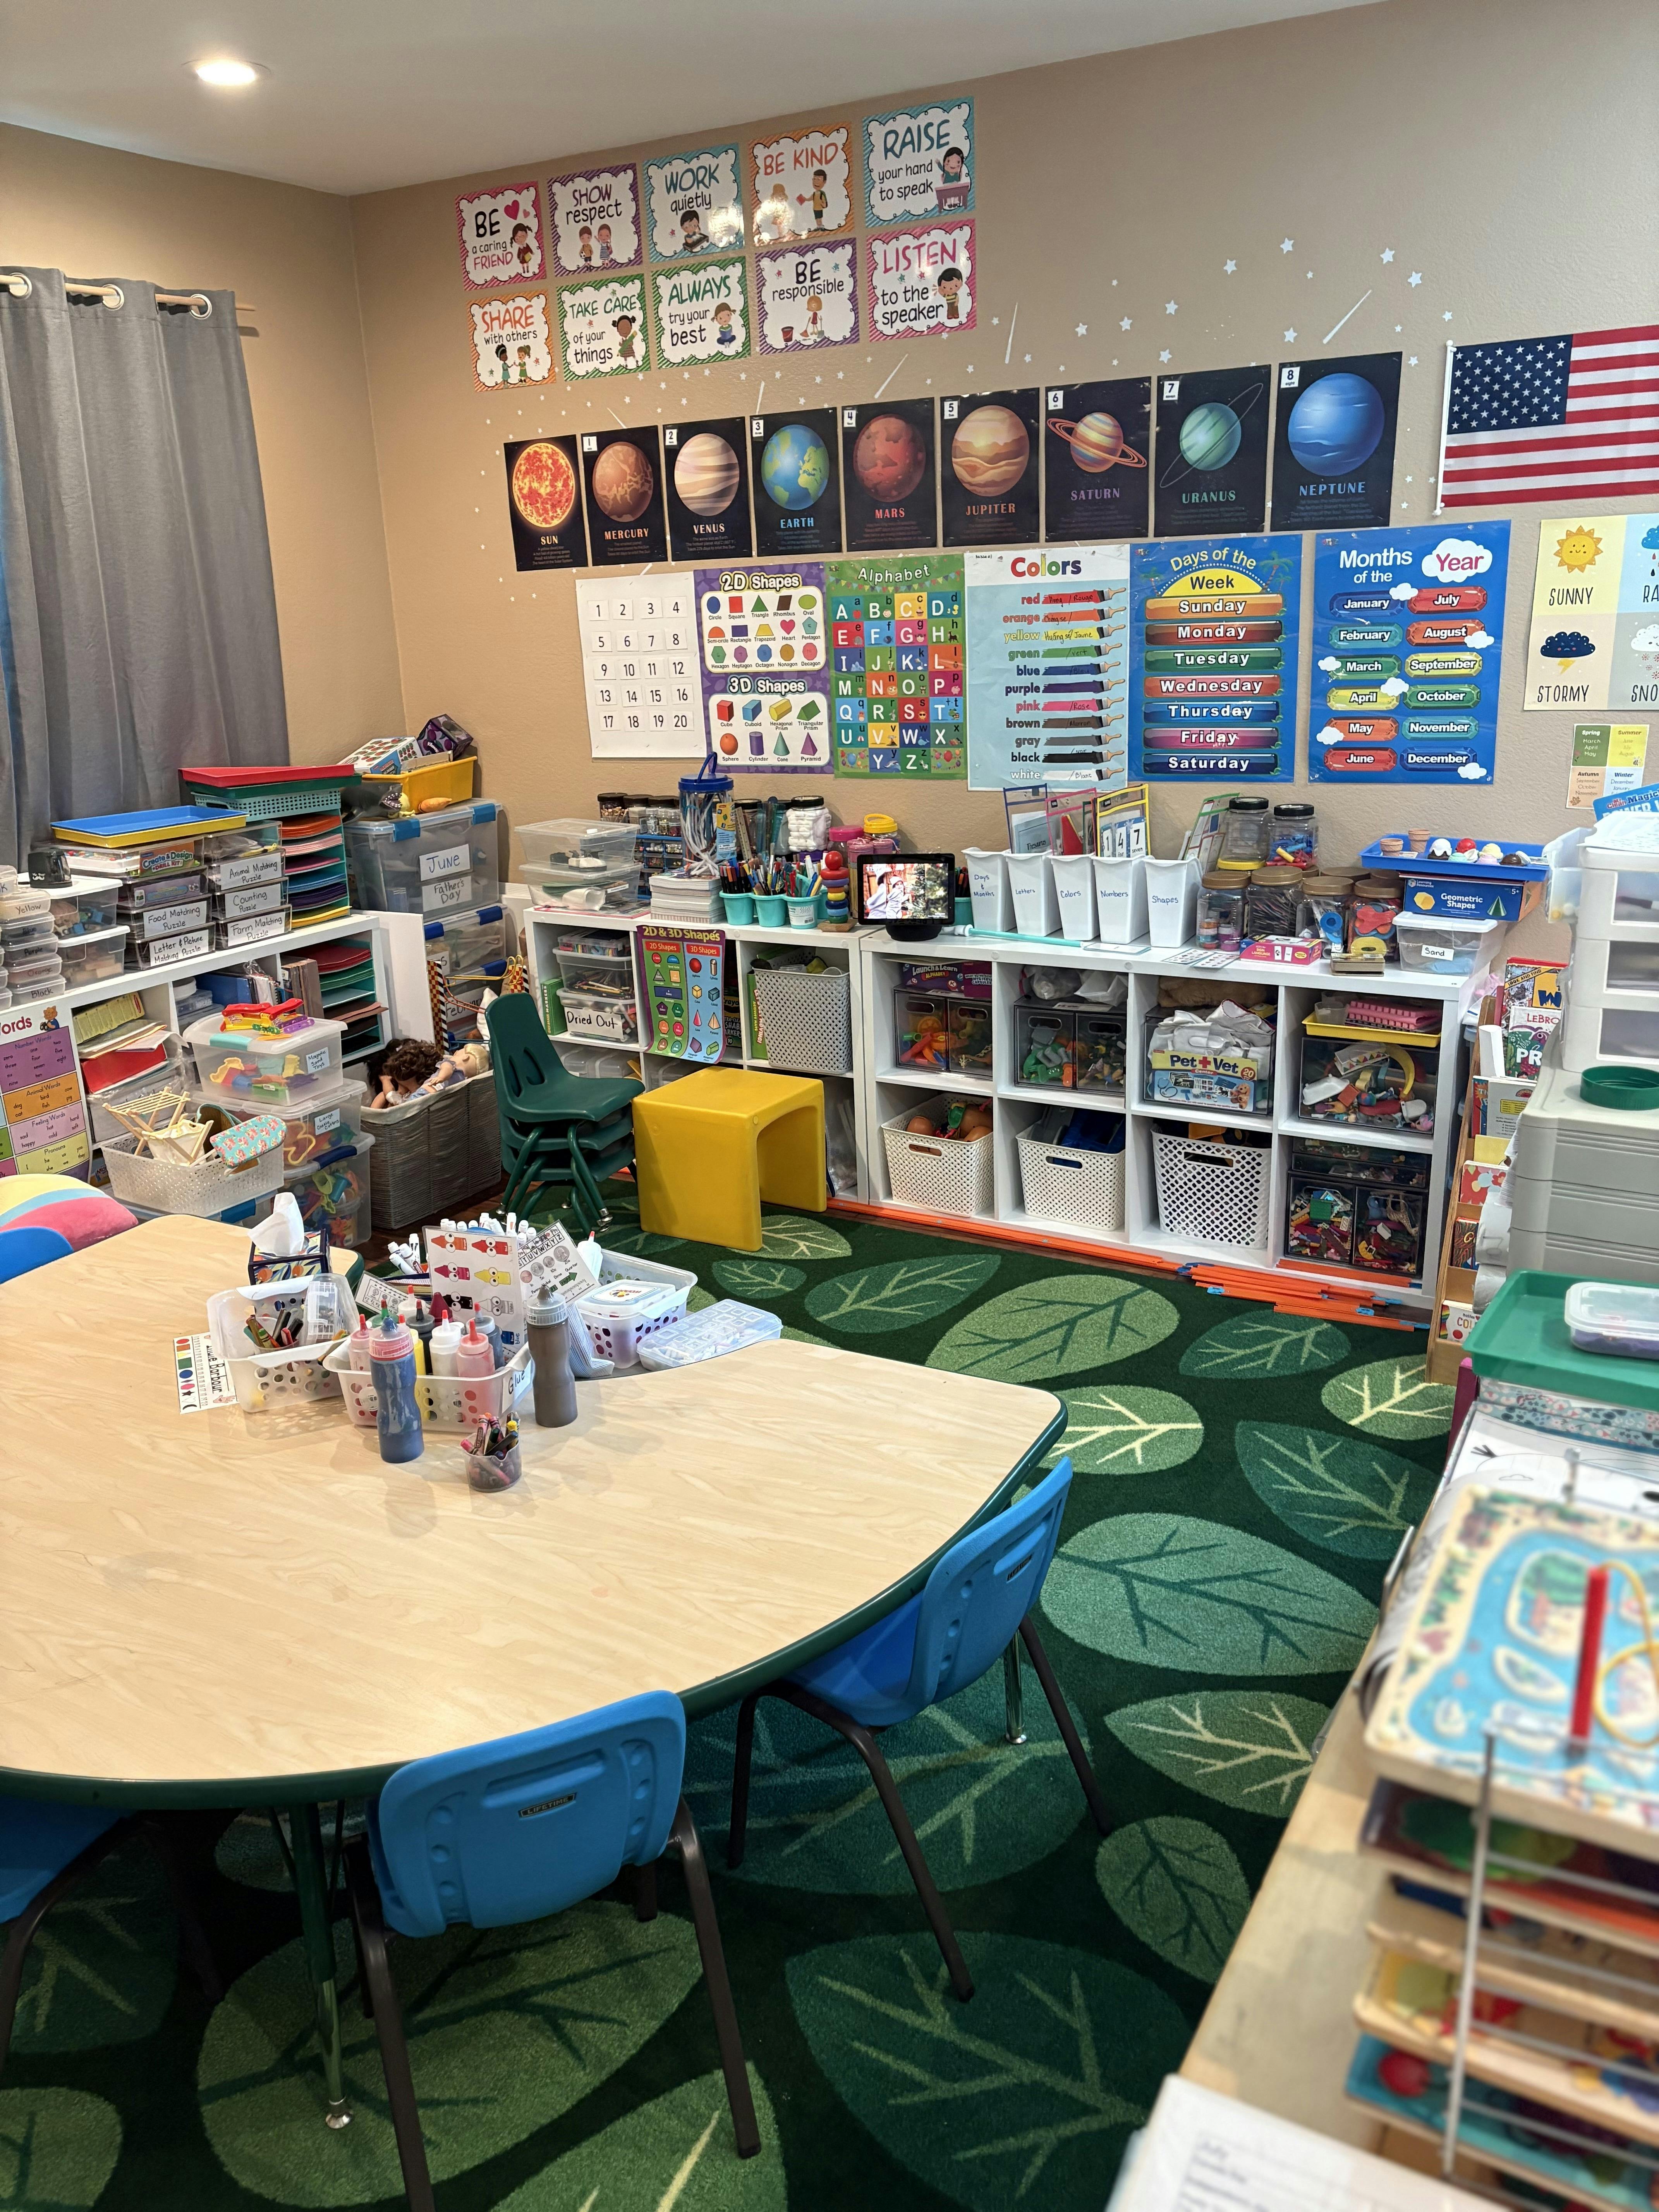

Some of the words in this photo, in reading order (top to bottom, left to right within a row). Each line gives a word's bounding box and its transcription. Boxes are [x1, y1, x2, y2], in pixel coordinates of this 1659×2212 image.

[883, 119, 951, 160] RAISE
[763, 153, 785, 175] BE
[793, 143, 839, 170] KIND
[665, 163, 720, 194] WORK
[878, 167, 903, 183] your
[905, 160, 933, 177] hand
[573, 184, 612, 207] SHOW
[879, 187, 894, 201] to
[897, 180, 934, 201] speak
[671, 192, 712, 212] quietly
[566, 199, 622, 225] respect
[474, 208, 501, 237] BE
[472, 246, 477, 254] a
[479, 241, 508, 254] caring
[474, 252, 513, 270] FRIEND
[883, 239, 957, 273] LISTEN
[795, 259, 821, 284] BE
[668, 275, 731, 306] ALWAYS
[772, 278, 845, 302] responsible
[881, 289, 898, 305] to
[903, 285, 929, 302] the
[569, 300, 599, 319] TAKE
[603, 294, 637, 314] CARE
[481, 304, 534, 333] SHARE
[668, 311, 685, 325] try
[687, 310, 710, 324] your
[882, 303, 944, 328] speaker
[484, 334, 503, 345] with
[505, 330, 538, 342] others
[573, 333, 584, 344] of
[586, 330, 606, 344] your
[670, 325, 707, 347] best
[573, 347, 613, 364] things
[1070, 488, 1120, 501] SATURN
[1299, 481, 1366, 496] NEPTUNE
[1182, 490, 1236, 504] URANUS
[875, 508, 905, 519] MARS
[966, 503, 1016, 515] JUPITER
[693, 524, 725, 534] VENUS
[780, 517, 814, 528] EARTH
[540, 536, 558, 545] SUN
[604, 529, 649, 540] MERCURY
[1170, 549, 1208, 571] Days
[1212, 548, 1229, 562] of
[1233, 551, 1256, 570] the
[1340, 548, 1413, 568] Months
[1435, 551, 1484, 572] Year
[858, 564, 930, 583] Alphabet
[1011, 557, 1082, 577] Colors
[721, 574, 746, 591] 2D
[752, 575, 799, 591] Shapes
[1190, 576, 1235, 590] Week
[1354, 572, 1368, 583] of
[1371, 570, 1393, 582] the
[1021, 595, 1040, 605] red
[1433, 594, 1460, 606] July
[1549, 587, 1593, 606] SUNNY
[1178, 599, 1247, 614] Sunday
[1343, 598, 1389, 610] January
[1003, 614, 1040, 623] orange
[1004, 631, 1040, 642] yellow
[1178, 625, 1247, 640] Monday
[1340, 629, 1391, 642] February
[1424, 627, 1467, 639] August
[1008, 649, 1040, 661] green
[1174, 652, 1250, 666] Tuesday
[1016, 666, 1040, 676] blue
[1346, 661, 1382, 672] March
[1410, 658, 1477, 672] September
[729, 678, 751, 693] 3D
[757, 679, 805, 695] Shapes
[1005, 684, 1040, 696] purple
[1160, 679, 1264, 693] Wednesday
[1350, 692, 1377, 704] April
[1417, 691, 1465, 702] October
[1538, 685, 1589, 703] STORMY
[1016, 701, 1041, 713] pink
[1168, 705, 1253, 719] Thursday
[1006, 719, 1041, 728] brown
[1348, 723, 1374, 735] May
[1409, 723, 1470, 733] November
[1015, 737, 1041, 747] gray
[1181, 731, 1237, 745] Friday
[1011, 752, 1040, 763] black
[1168, 757, 1250, 770] Saturday
[1346, 754, 1374, 764] June
[1407, 754, 1468, 765] December
[1011, 771, 1041, 780] white
[229, 866, 250, 879] Animal
[253, 861, 277, 872] Matching
[242, 874, 261, 884] Puzzle
[434, 879, 464, 893] Father's
[233, 891, 267, 906] Counting
[441, 890, 460, 904] Day
[1100, 890, 1128, 898] Numbers
[1152, 896, 1179, 905] Shapes
[1441, 893, 1483, 903] Geometric
[15, 904, 41, 914] Yellow
[239, 904, 256, 913] Puzzle
[1447, 901, 1475, 909] Shapes
[148, 911, 166, 924] Food
[170, 907, 200, 917] Matching
[163, 920, 185, 930] Puzzle
[231, 924, 253, 936] Farm
[255, 916, 282, 928] Matching
[247, 930, 268, 941] Puzzle
[643, 926, 657, 936] 2D
[658, 928, 666, 937] &
[668, 928, 682, 938] 3D
[684, 930, 720, 942] Shapes
[153, 942, 175, 954] Letter
[183, 935, 203, 945] Picture
[155, 951, 179, 963] Matching
[182, 946, 201, 955] Puzzle
[1425, 948, 1445, 957] Sand
[31, 988, 53, 998] Black
[567, 1011, 592, 1025] Dried
[596, 1014, 618, 1028] Out
[1170, 1054, 1197, 1068] Pet
[1212, 1057, 1239, 1074] Vet
[1243, 1067, 1254, 1077] 20
[26, 1087, 44, 1097] Animal
[45, 1082, 60, 1091] Words
[508, 1370, 525, 1394] Glue
[527, 1796, 569, 1815] LIFETIME
